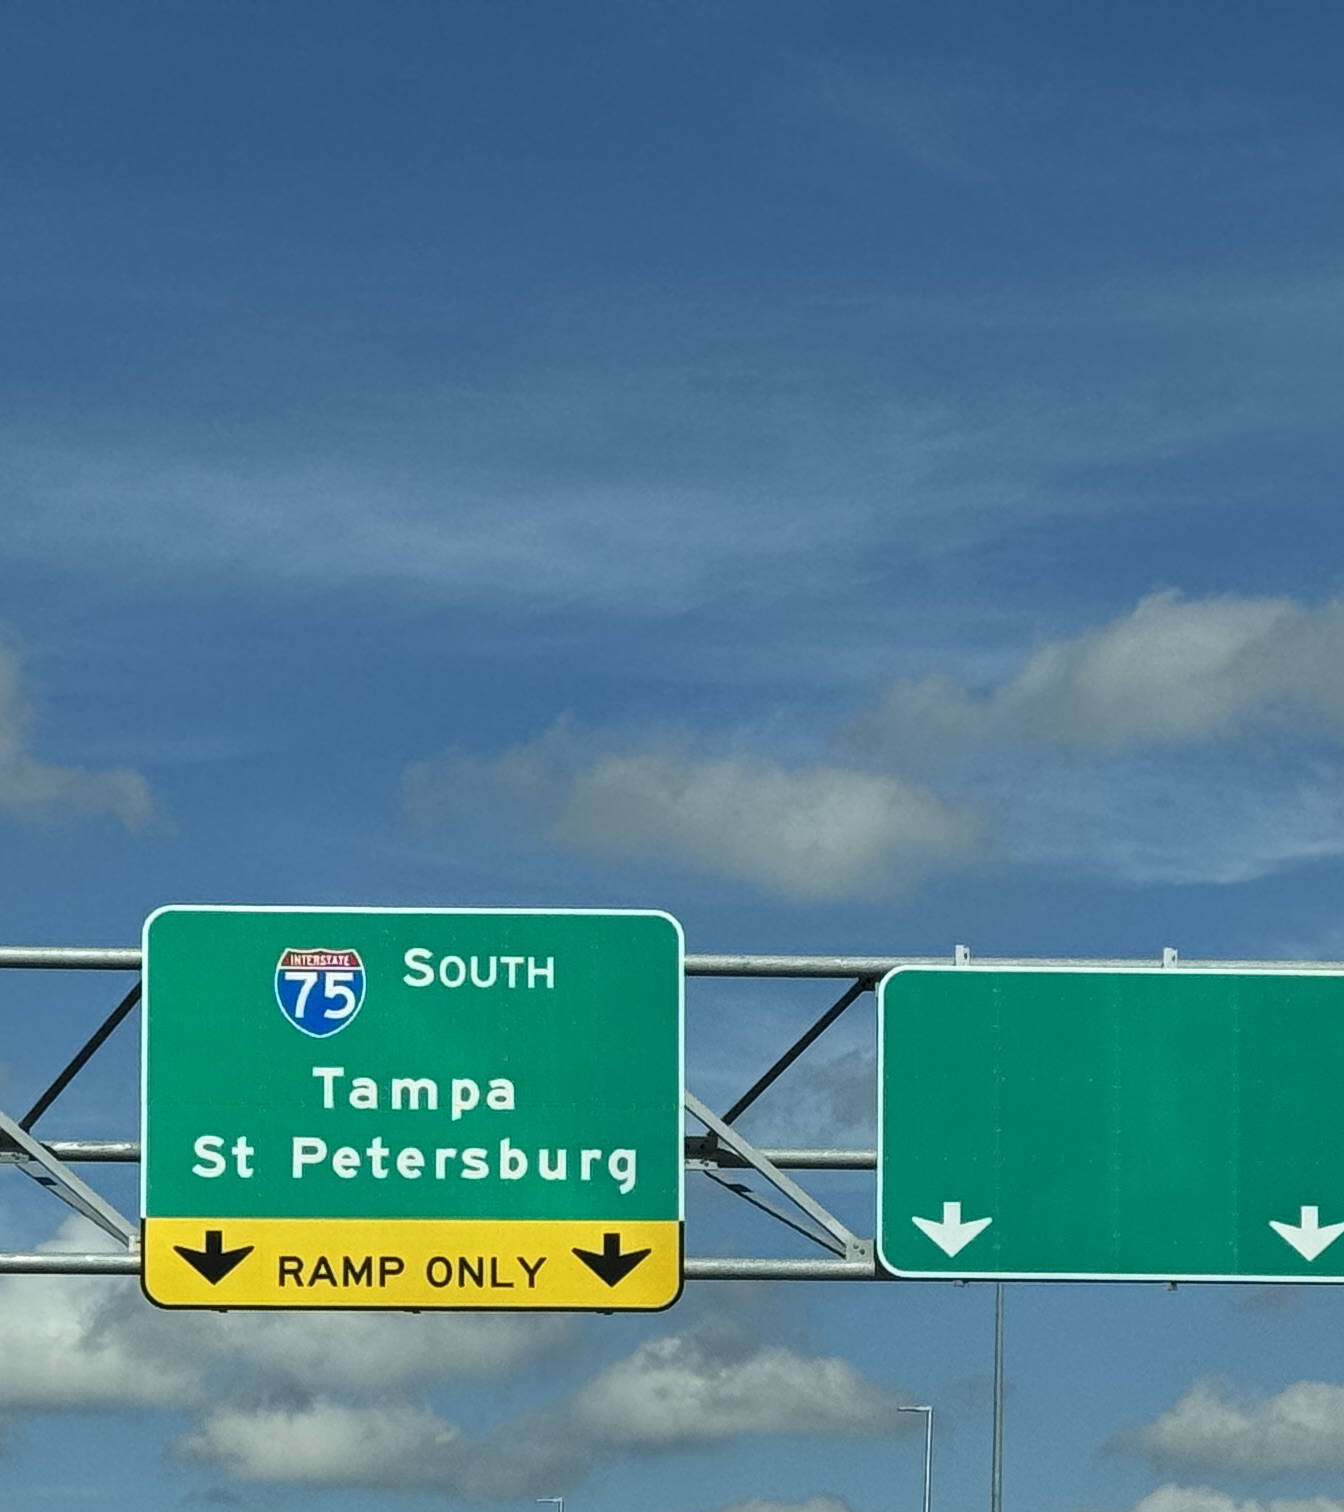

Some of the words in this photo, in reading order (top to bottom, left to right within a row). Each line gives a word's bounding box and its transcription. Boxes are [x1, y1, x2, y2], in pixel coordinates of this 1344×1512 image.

[290, 954, 351, 967] INTERSTATE
[402, 948, 555, 990] SOUTH
[285, 971, 355, 1019] 75
[312, 1066, 515, 1121] Tampa
[192, 1136, 255, 1178] St
[292, 1137, 638, 1194] Petersburg
[278, 1256, 405, 1289] RAMP
[426, 1256, 547, 1289] ONLY
